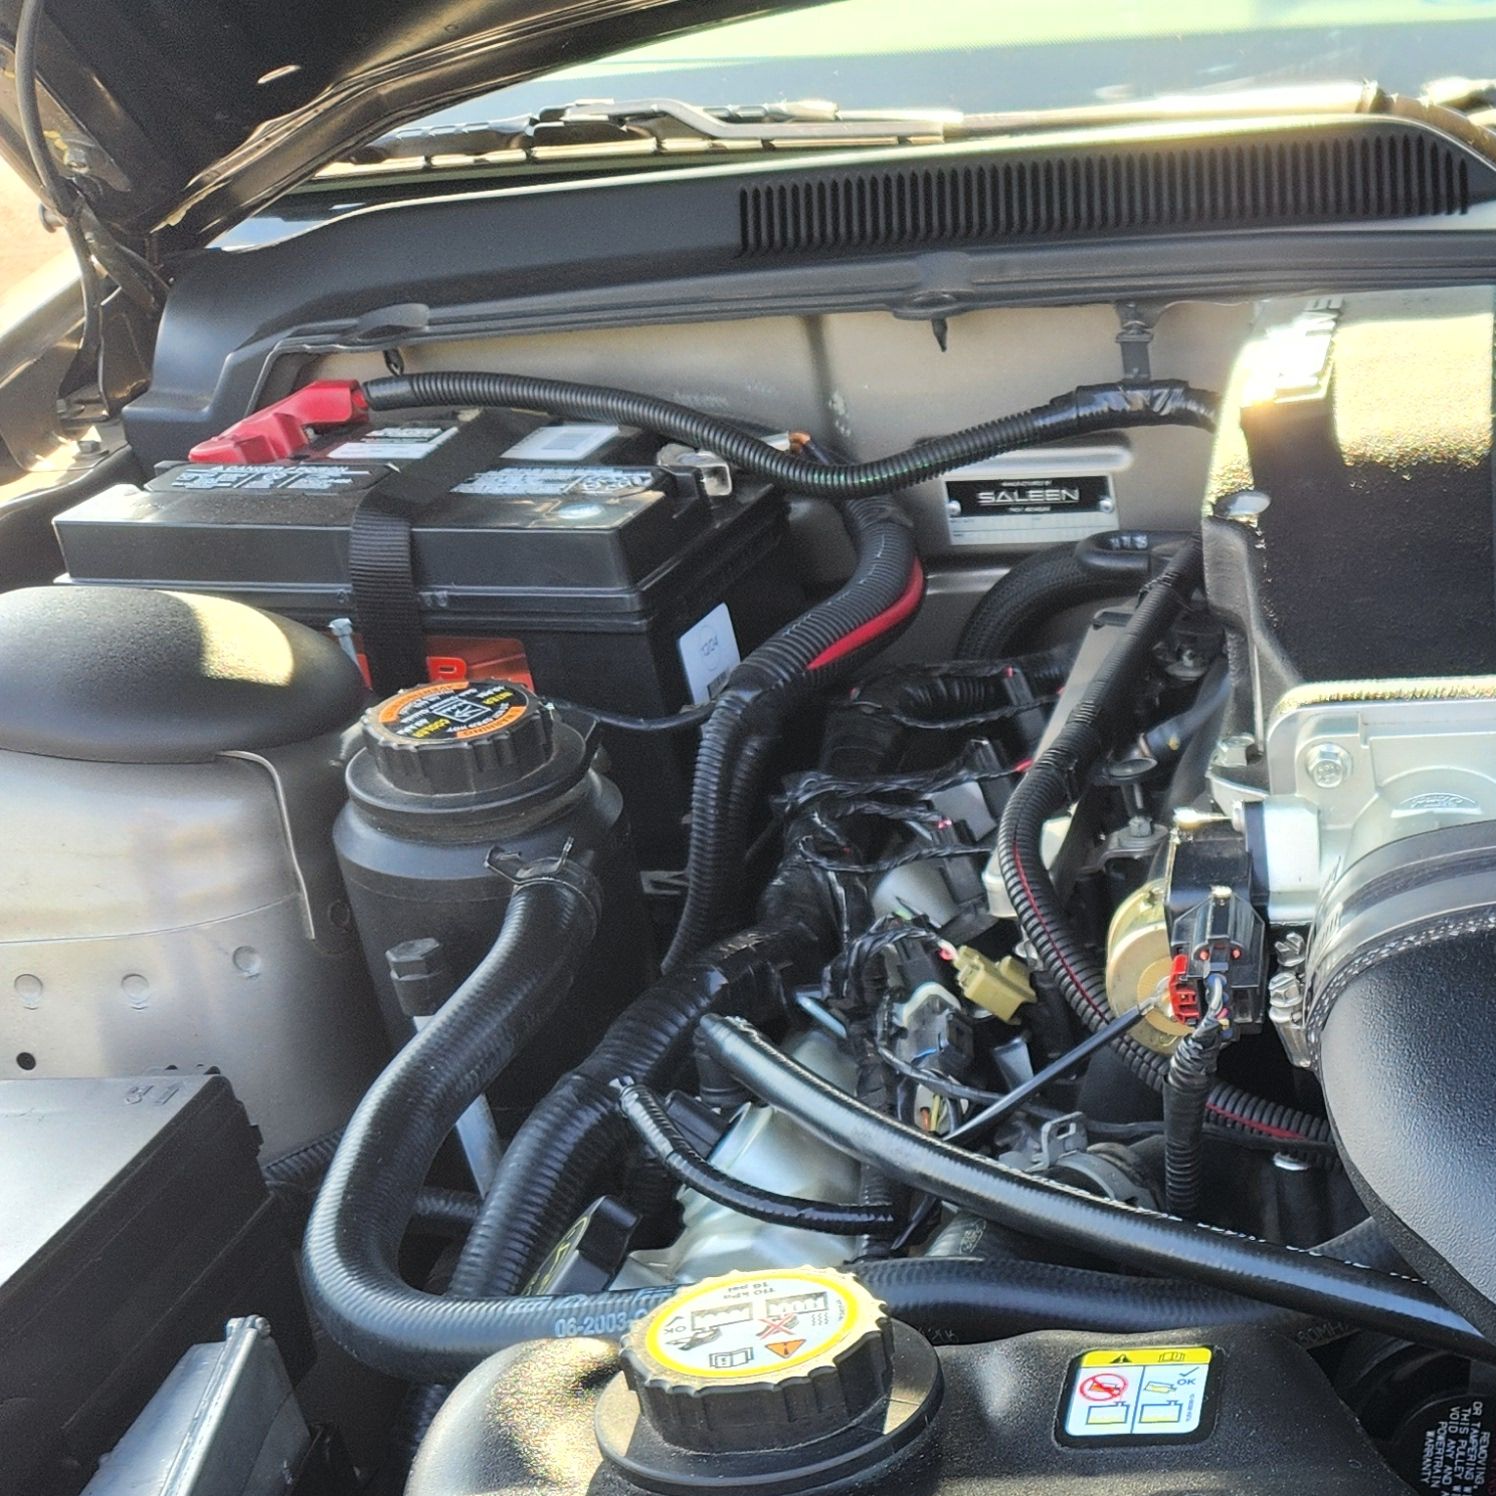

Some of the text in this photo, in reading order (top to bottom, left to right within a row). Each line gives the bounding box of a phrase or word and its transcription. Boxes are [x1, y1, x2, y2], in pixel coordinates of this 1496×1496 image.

[977, 488, 1080, 504] SALEEN
[664, 1325, 686, 1335] OK
[1177, 1378, 1197, 1386] OK
[1448, 1406, 1461, 1433] VOID
[1472, 1401, 1483, 1416] OR
[1459, 1407, 1471, 1434] THIS
[1420, 1430, 1435, 1484] WARRANTY
[1430, 1421, 1449, 1488] POWERTRAIN
[1446, 1439, 1456, 1459] ANY
[1454, 1439, 1468, 1480] PULLEY
[1464, 1422, 1481, 1480] TAMPERING
[1442, 1465, 1453, 1485] AND
